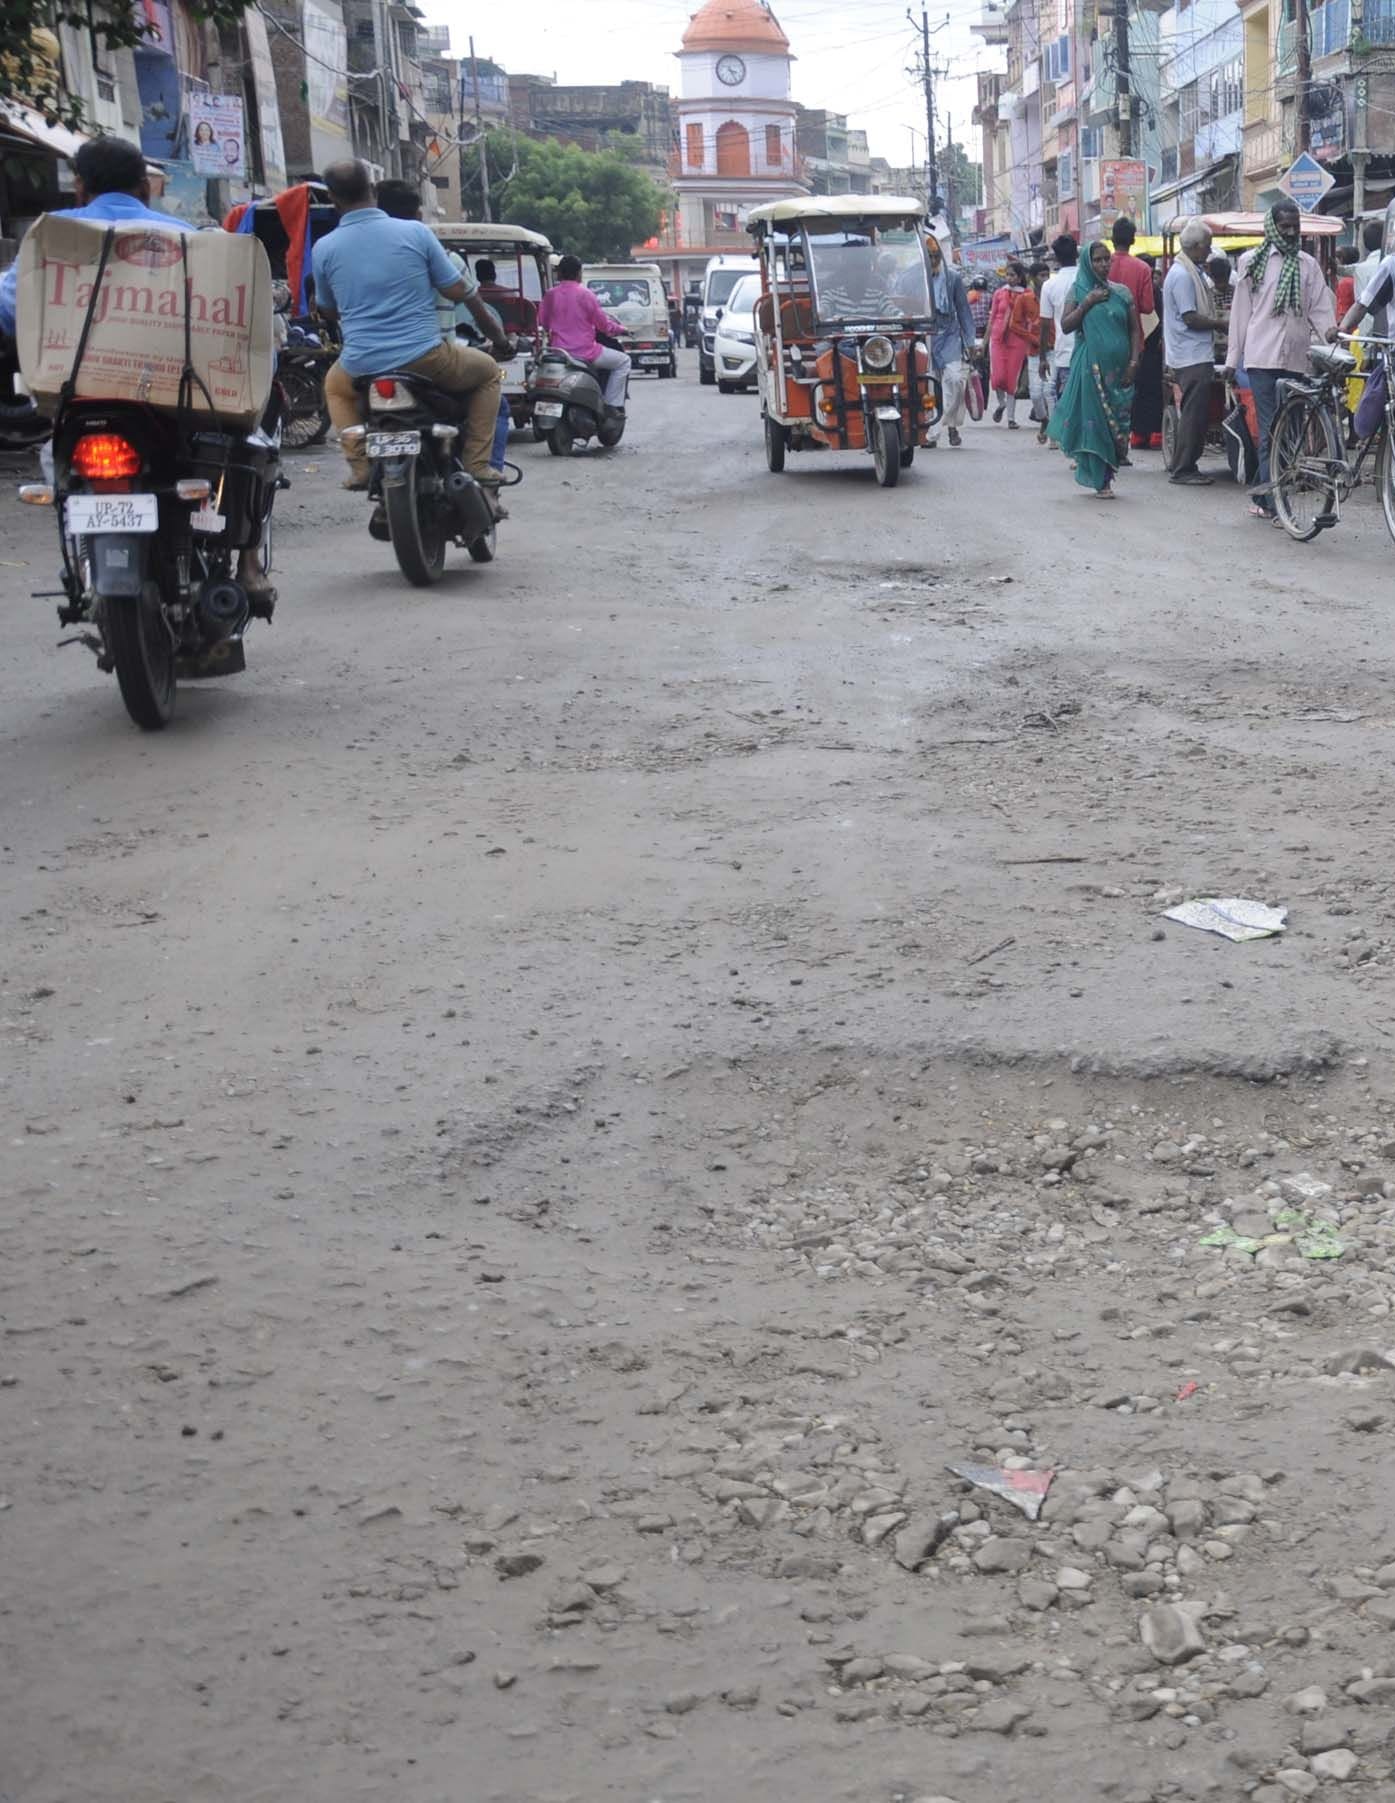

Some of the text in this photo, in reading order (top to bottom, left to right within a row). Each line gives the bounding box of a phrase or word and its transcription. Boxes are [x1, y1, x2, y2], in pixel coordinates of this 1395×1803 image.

[40, 258, 248, 328] Tajmahal
[95, 502, 135, 516] UP-72
[86, 515, 143, 528] AY-5437
